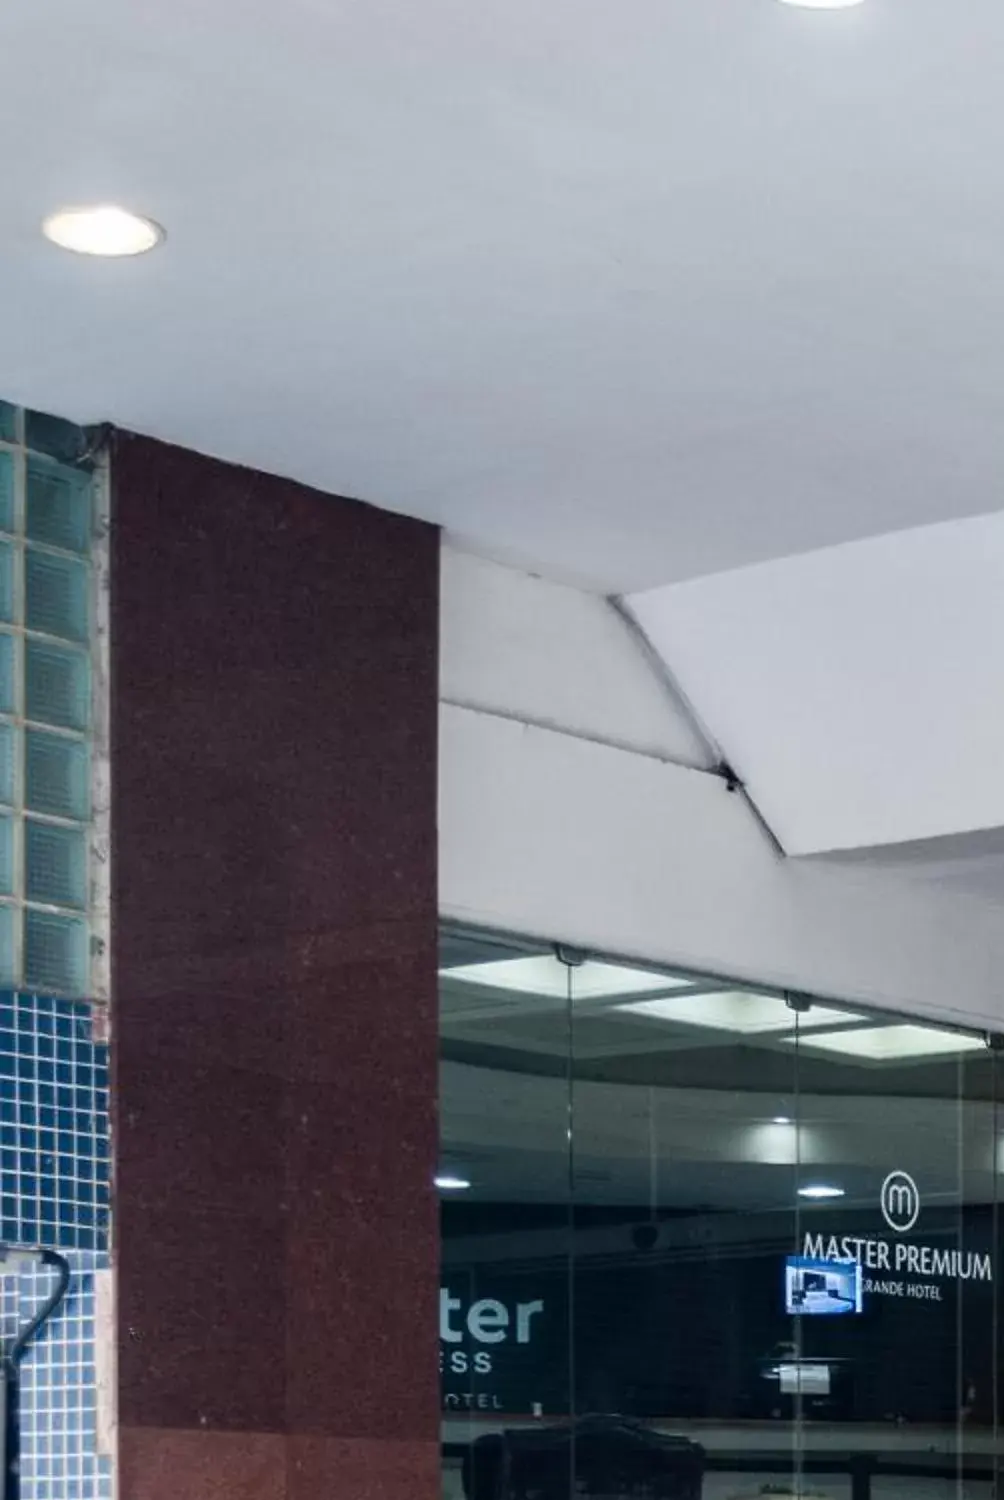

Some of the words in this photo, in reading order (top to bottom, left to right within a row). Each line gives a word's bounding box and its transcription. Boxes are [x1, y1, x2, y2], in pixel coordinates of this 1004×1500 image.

[803, 1231, 890, 1271] MASTER
[895, 1243, 992, 1281] PREMIUM
[907, 1283, 944, 1301] HOTEL
